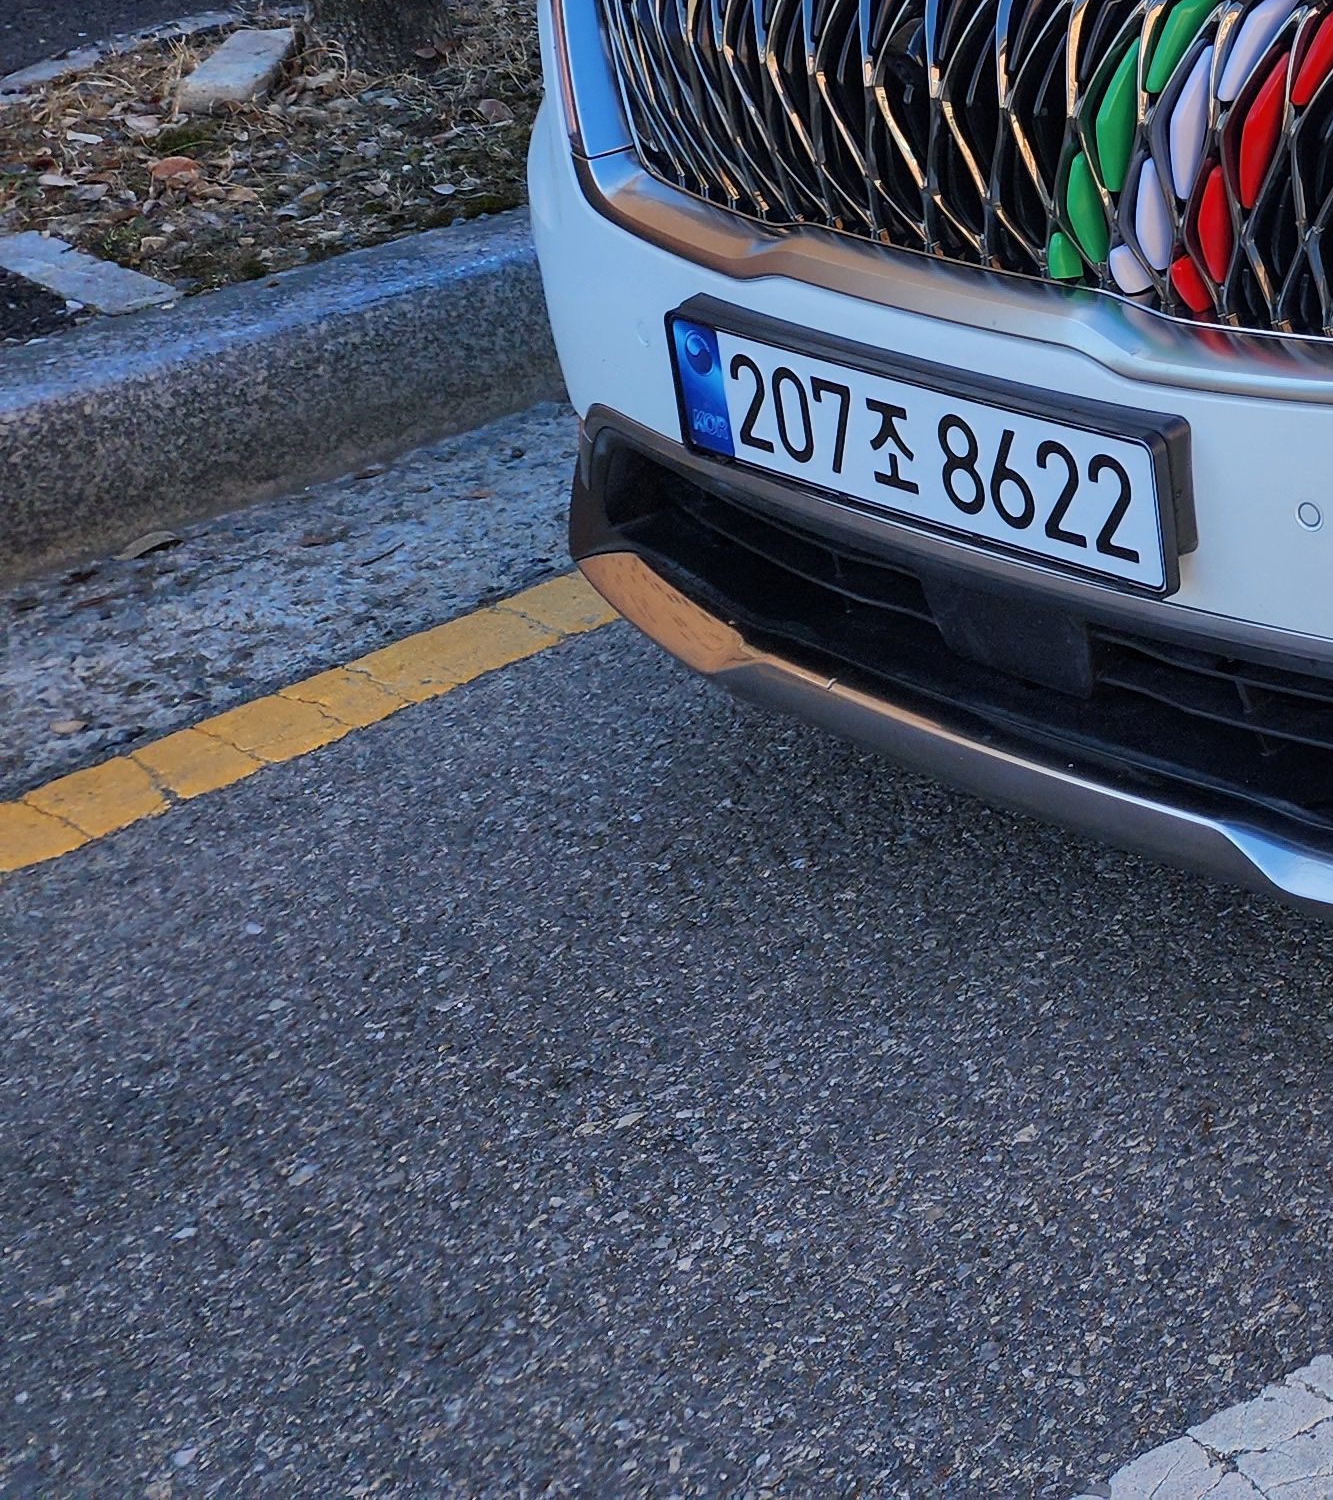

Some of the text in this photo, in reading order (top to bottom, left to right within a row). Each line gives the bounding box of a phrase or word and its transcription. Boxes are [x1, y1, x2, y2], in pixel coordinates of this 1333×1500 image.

[693, 408, 729, 440] KOR
[730, 354, 1140, 564] 207조 8622
